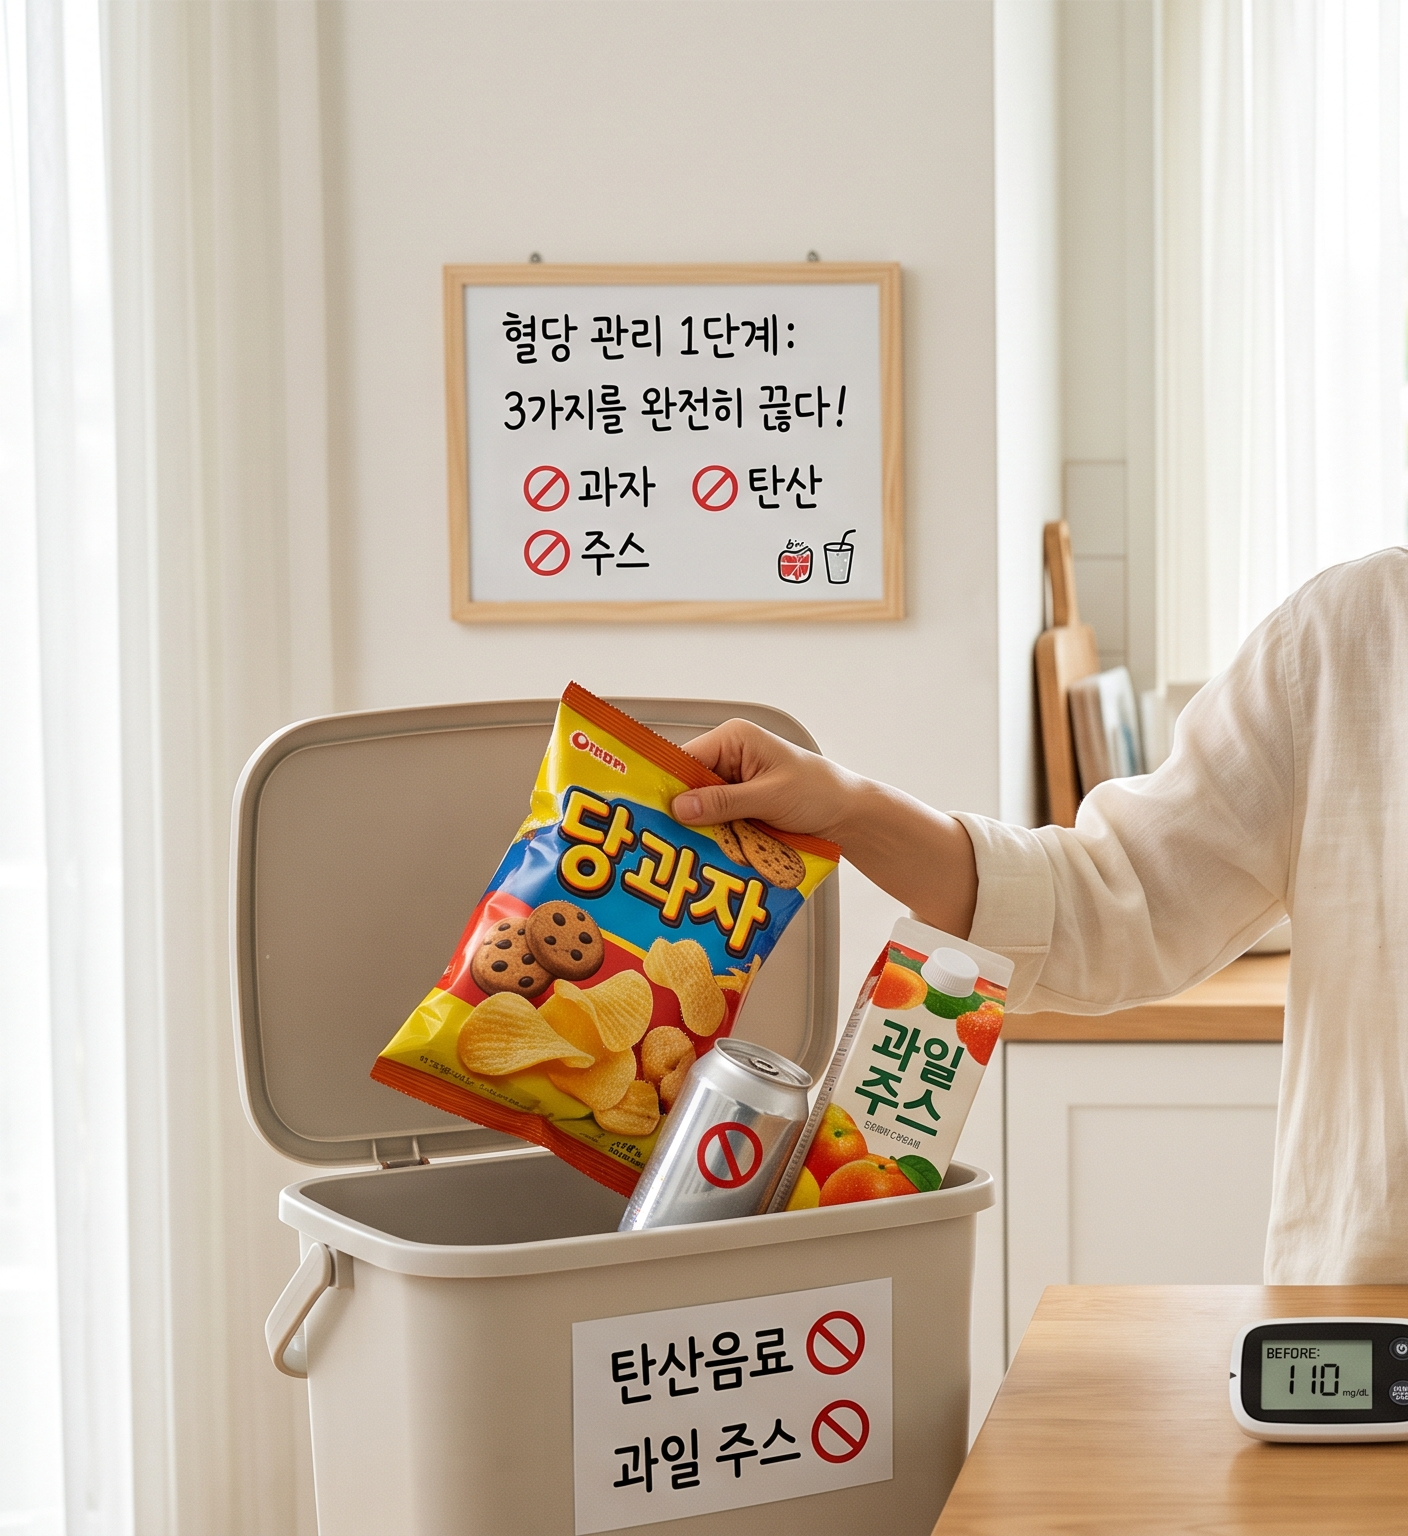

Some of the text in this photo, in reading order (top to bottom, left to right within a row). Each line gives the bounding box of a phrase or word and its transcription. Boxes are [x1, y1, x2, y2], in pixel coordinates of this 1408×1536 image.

[502, 311, 796, 365] 혈당 관리 1단계:
[503, 384, 847, 435] 3가지를 완전히 끊다!
[577, 465, 657, 508] 과자
[748, 464, 823, 510] 탄산
[580, 530, 650, 577] 주스
[558, 787, 771, 957] 당과자
[871, 1018, 965, 1091] 과일
[854, 1065, 942, 1137] 주스
[611, 1327, 794, 1405] 탄산음료
[1266, 1347, 1320, 1360] BEFORE:
[1289, 1363, 1340, 1397] 110
[1342, 1388, 1370, 1399] mg/dL
[612, 1418, 802, 1494] 과일 주스
